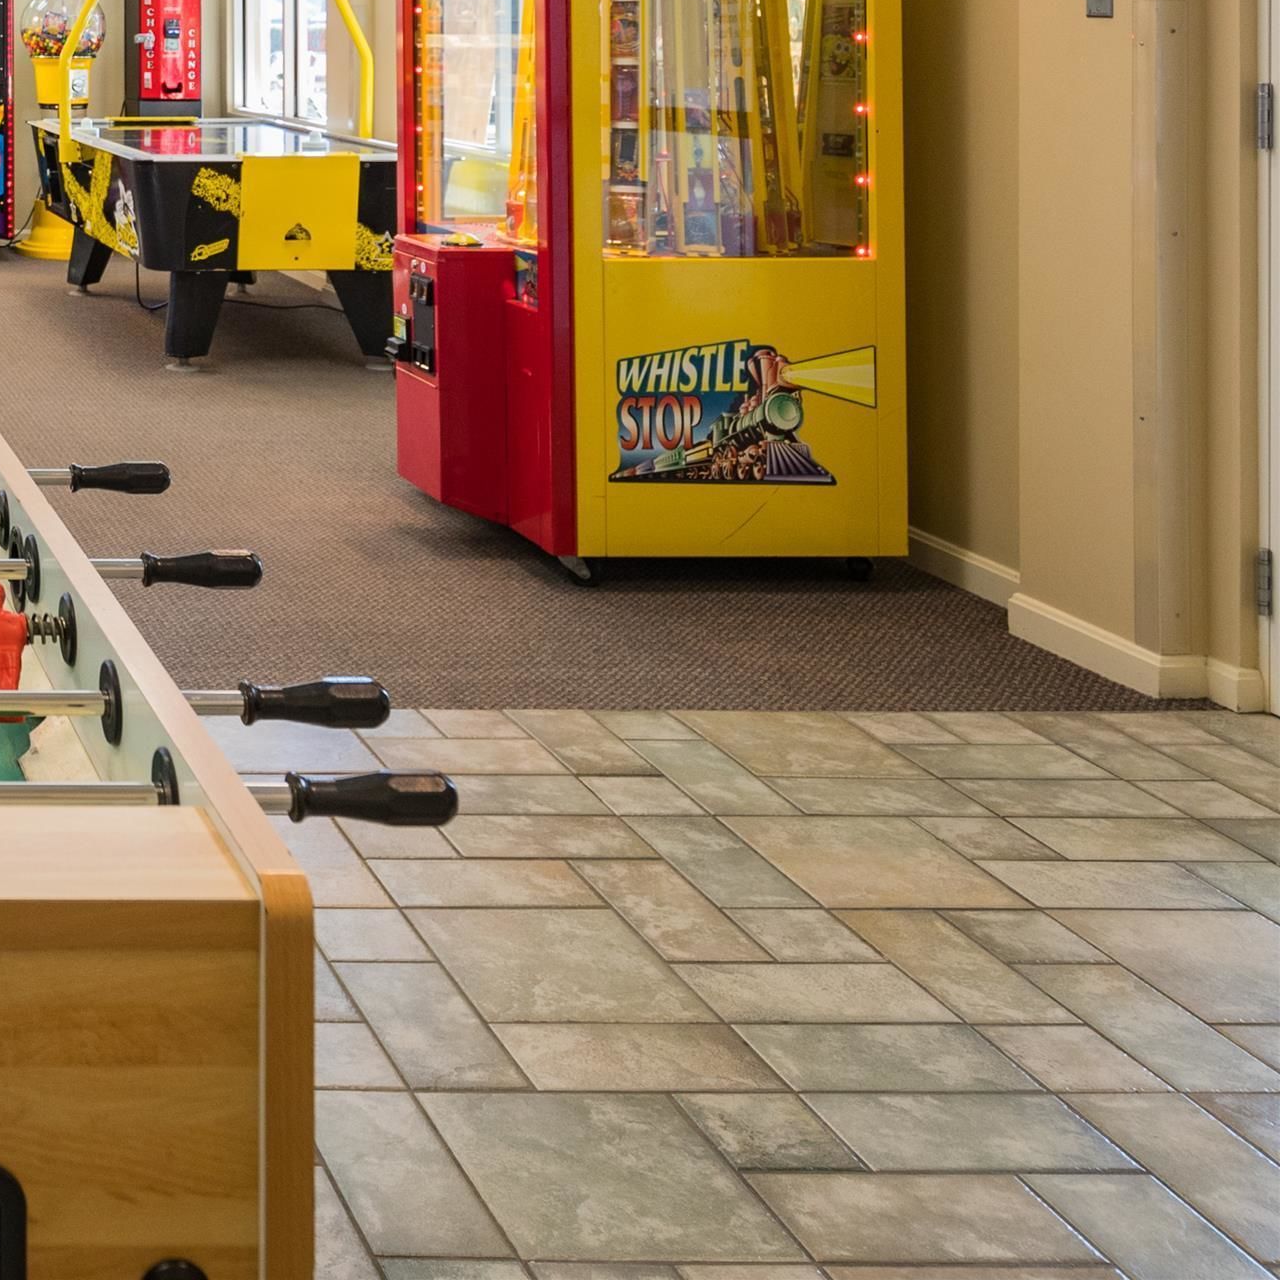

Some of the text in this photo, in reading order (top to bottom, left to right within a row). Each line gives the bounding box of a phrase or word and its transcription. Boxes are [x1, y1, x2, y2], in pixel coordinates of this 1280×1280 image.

[188, 28, 197, 91] CHANGE
[619, 340, 751, 393] WHISTLE
[619, 395, 703, 451] STOP
